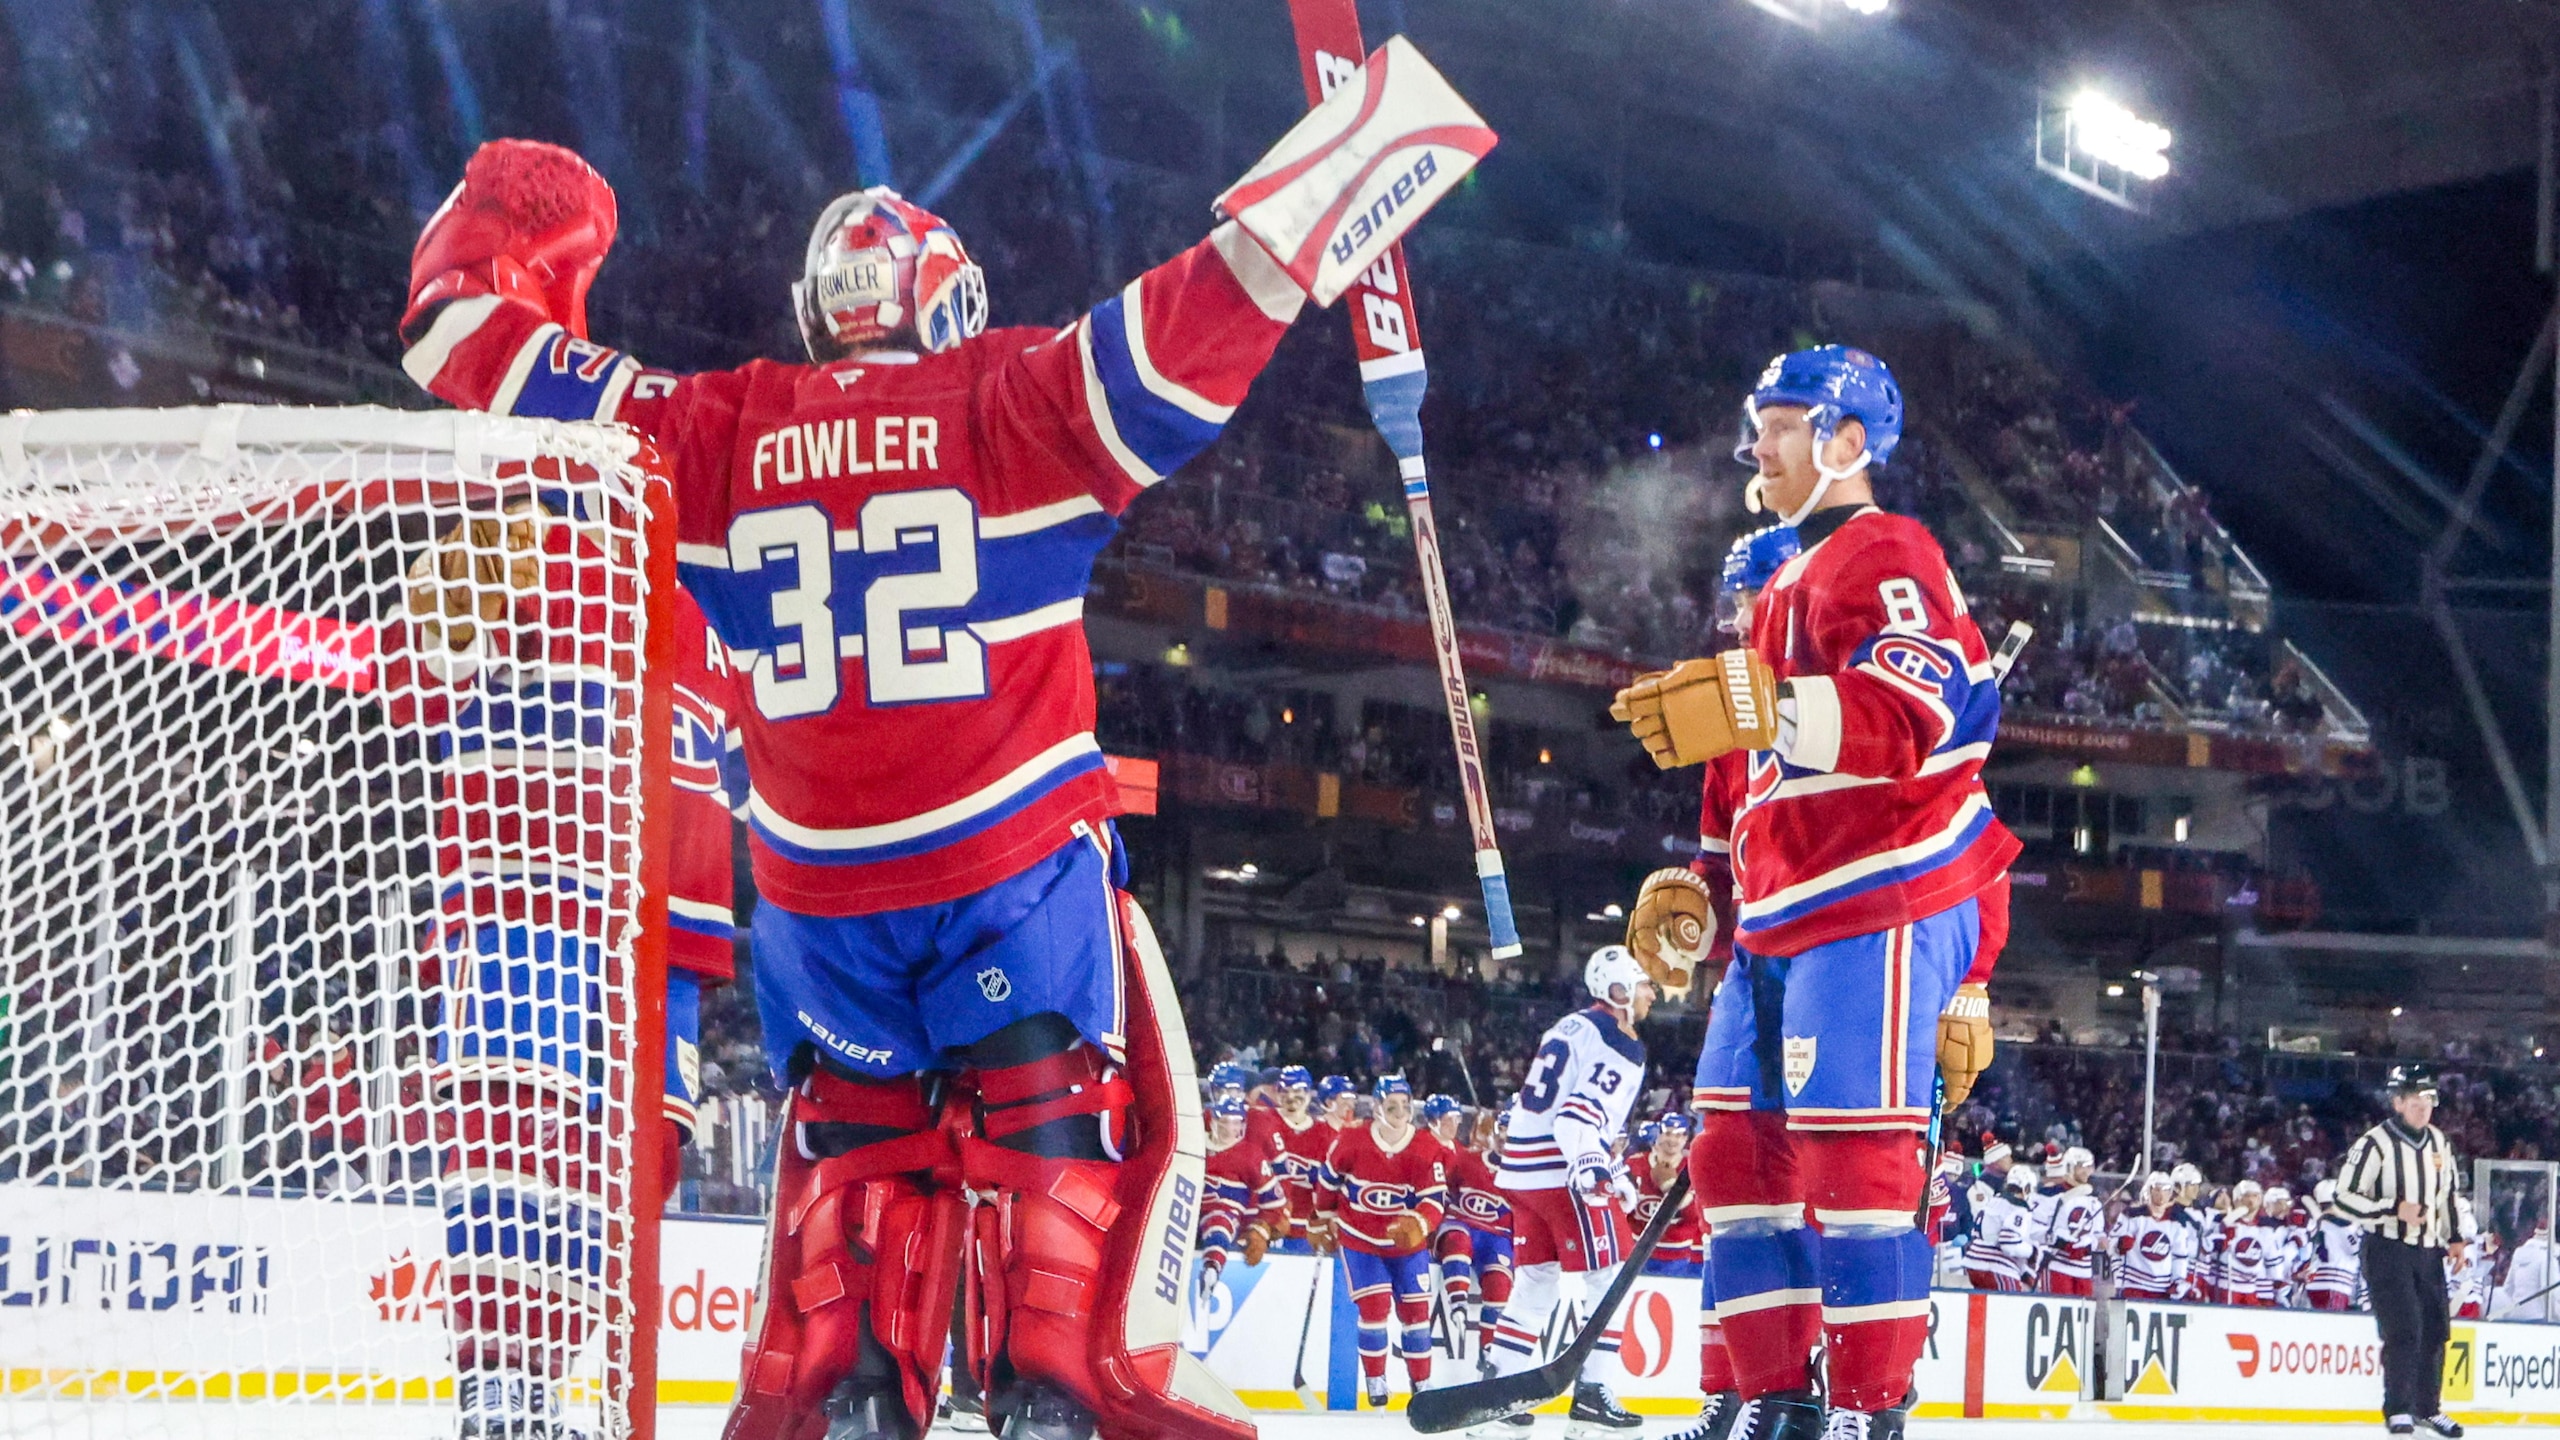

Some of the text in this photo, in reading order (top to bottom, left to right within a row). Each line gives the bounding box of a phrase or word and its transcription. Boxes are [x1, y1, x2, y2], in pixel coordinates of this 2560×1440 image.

[753, 416, 938, 491] FOWLER
[727, 487, 988, 722] 32
[1878, 577, 1930, 631] 8
[1723, 649, 1759, 730] RRIOR
[1941, 996, 1990, 1018] RIOR
[1520, 1037, 1570, 1115] 3
[1587, 1061, 1622, 1095] 13
[2124, 1308, 2187, 1395] CAT
